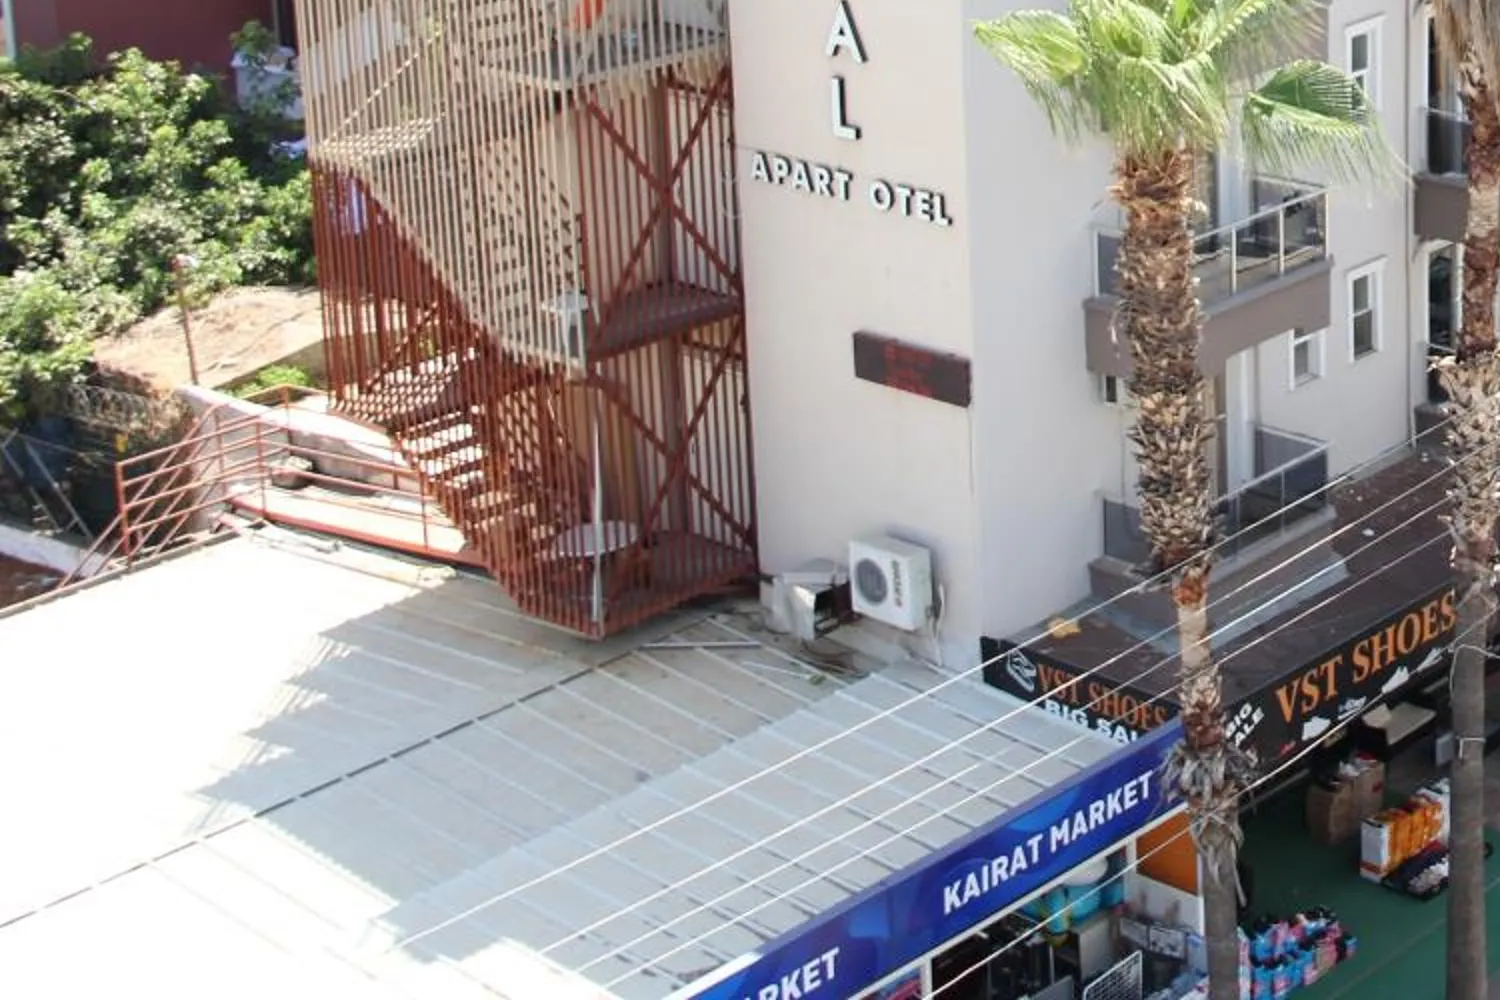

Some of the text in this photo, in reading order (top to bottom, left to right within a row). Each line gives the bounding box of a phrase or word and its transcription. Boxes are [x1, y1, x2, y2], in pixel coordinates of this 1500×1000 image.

[750, 152, 953, 226] APART OTEL
[1275, 589, 1458, 724] VST SHOES
[1036, 663, 1168, 731] VST SHOES
[1044, 699, 1139, 746] BIG SAL
[1235, 707, 1265, 749] ALE
[943, 770, 1153, 915] KAIRAT MARKET
[744, 946, 840, 1000] RKET
